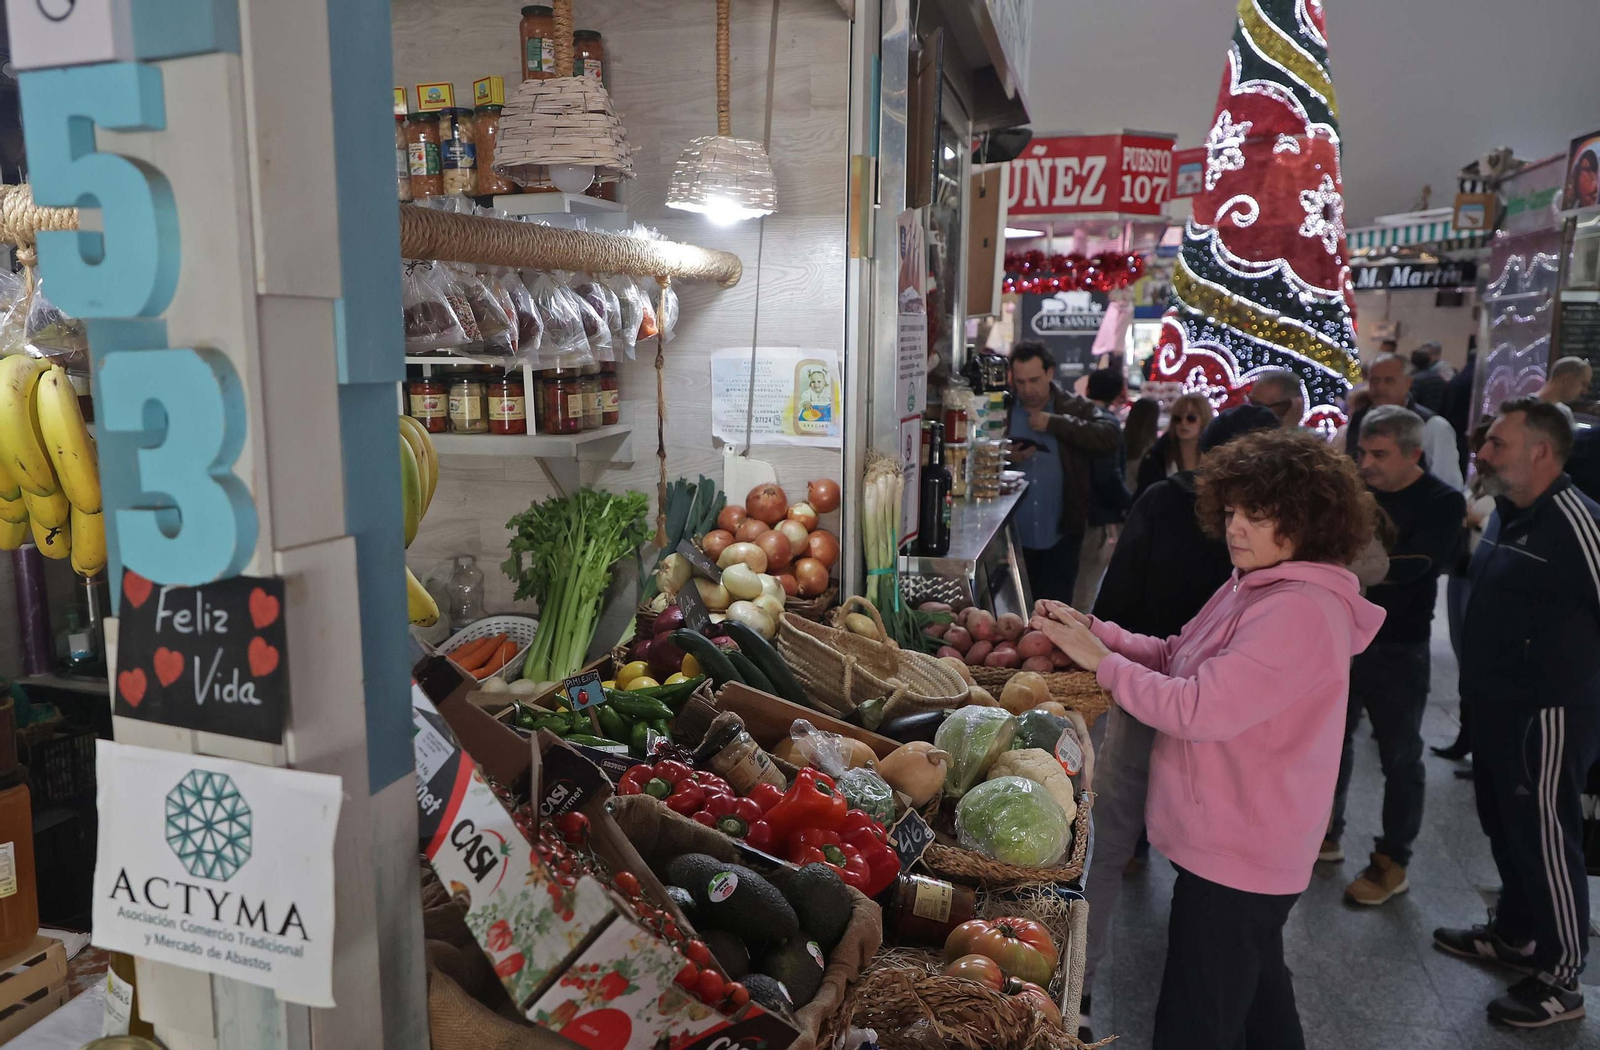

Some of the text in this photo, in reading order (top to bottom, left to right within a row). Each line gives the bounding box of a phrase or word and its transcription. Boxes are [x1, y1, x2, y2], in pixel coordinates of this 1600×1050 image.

[1121, 146, 1171, 173] PUESTO
[18, 62, 182, 320] 5
[1120, 175, 1169, 205] 107
[99, 347, 260, 588] 3
[155, 585, 229, 635] Feliz
[193, 647, 263, 706] Vida
[565, 673, 599, 688] PIMIENTO
[540, 784, 569, 816] CASI
[451, 819, 499, 883] CASI
[108, 866, 311, 942] ACTYMA
[117, 906, 305, 958] Asociación Comercio Tradicional
[144, 933, 272, 972] y Mercado de Abastos
